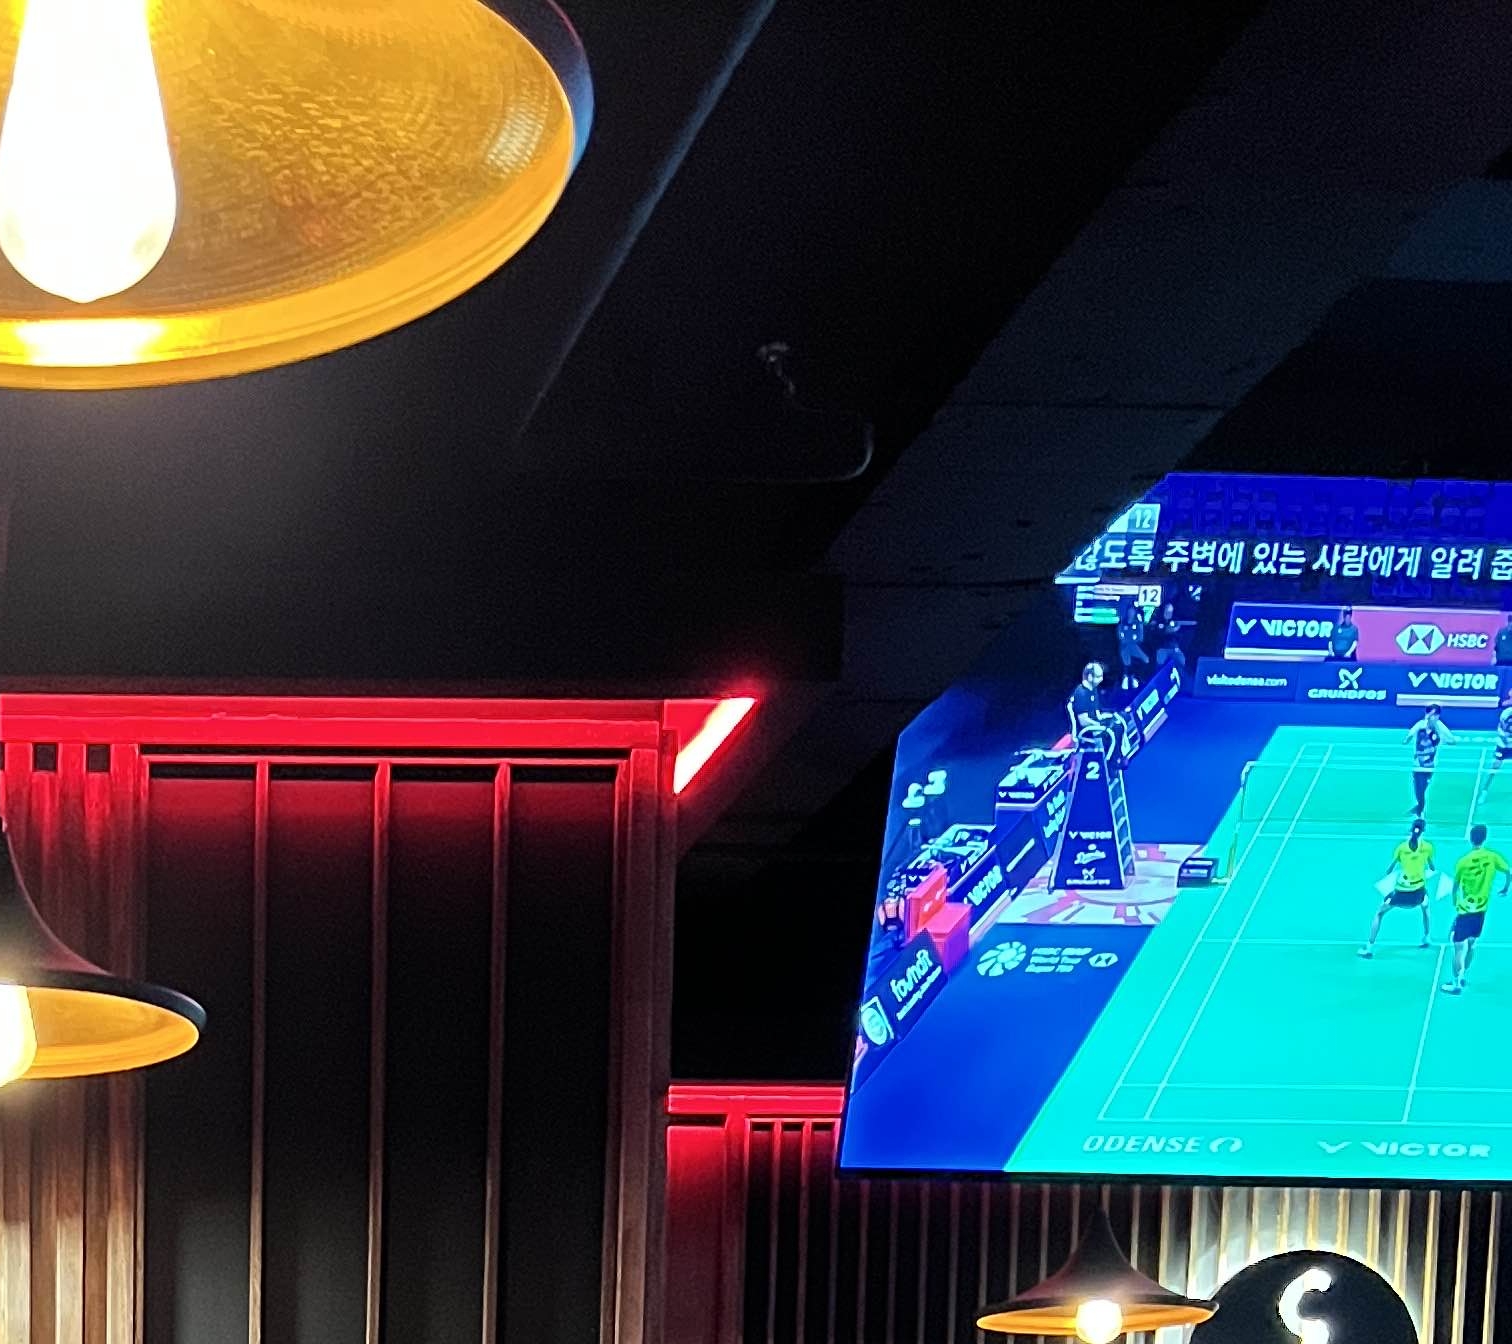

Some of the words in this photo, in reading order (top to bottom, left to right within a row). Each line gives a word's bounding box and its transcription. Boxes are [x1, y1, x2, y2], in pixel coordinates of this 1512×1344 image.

[1162, 540, 1245, 574] 주변에
[1251, 540, 1306, 576] 있는
[1312, 543, 1423, 578] 사람에게
[1431, 547, 1484, 580] 알려
[1143, 588, 1159, 604] 12
[1261, 619, 1334, 638] VICTOR
[1447, 632, 1489, 649] HSBC
[1430, 672, 1499, 690] VICTOR
[1085, 761, 1100, 780] 2
[1082, 1134, 1203, 1154] ODENSE
[1360, 1140, 1492, 1158] VICTOR
